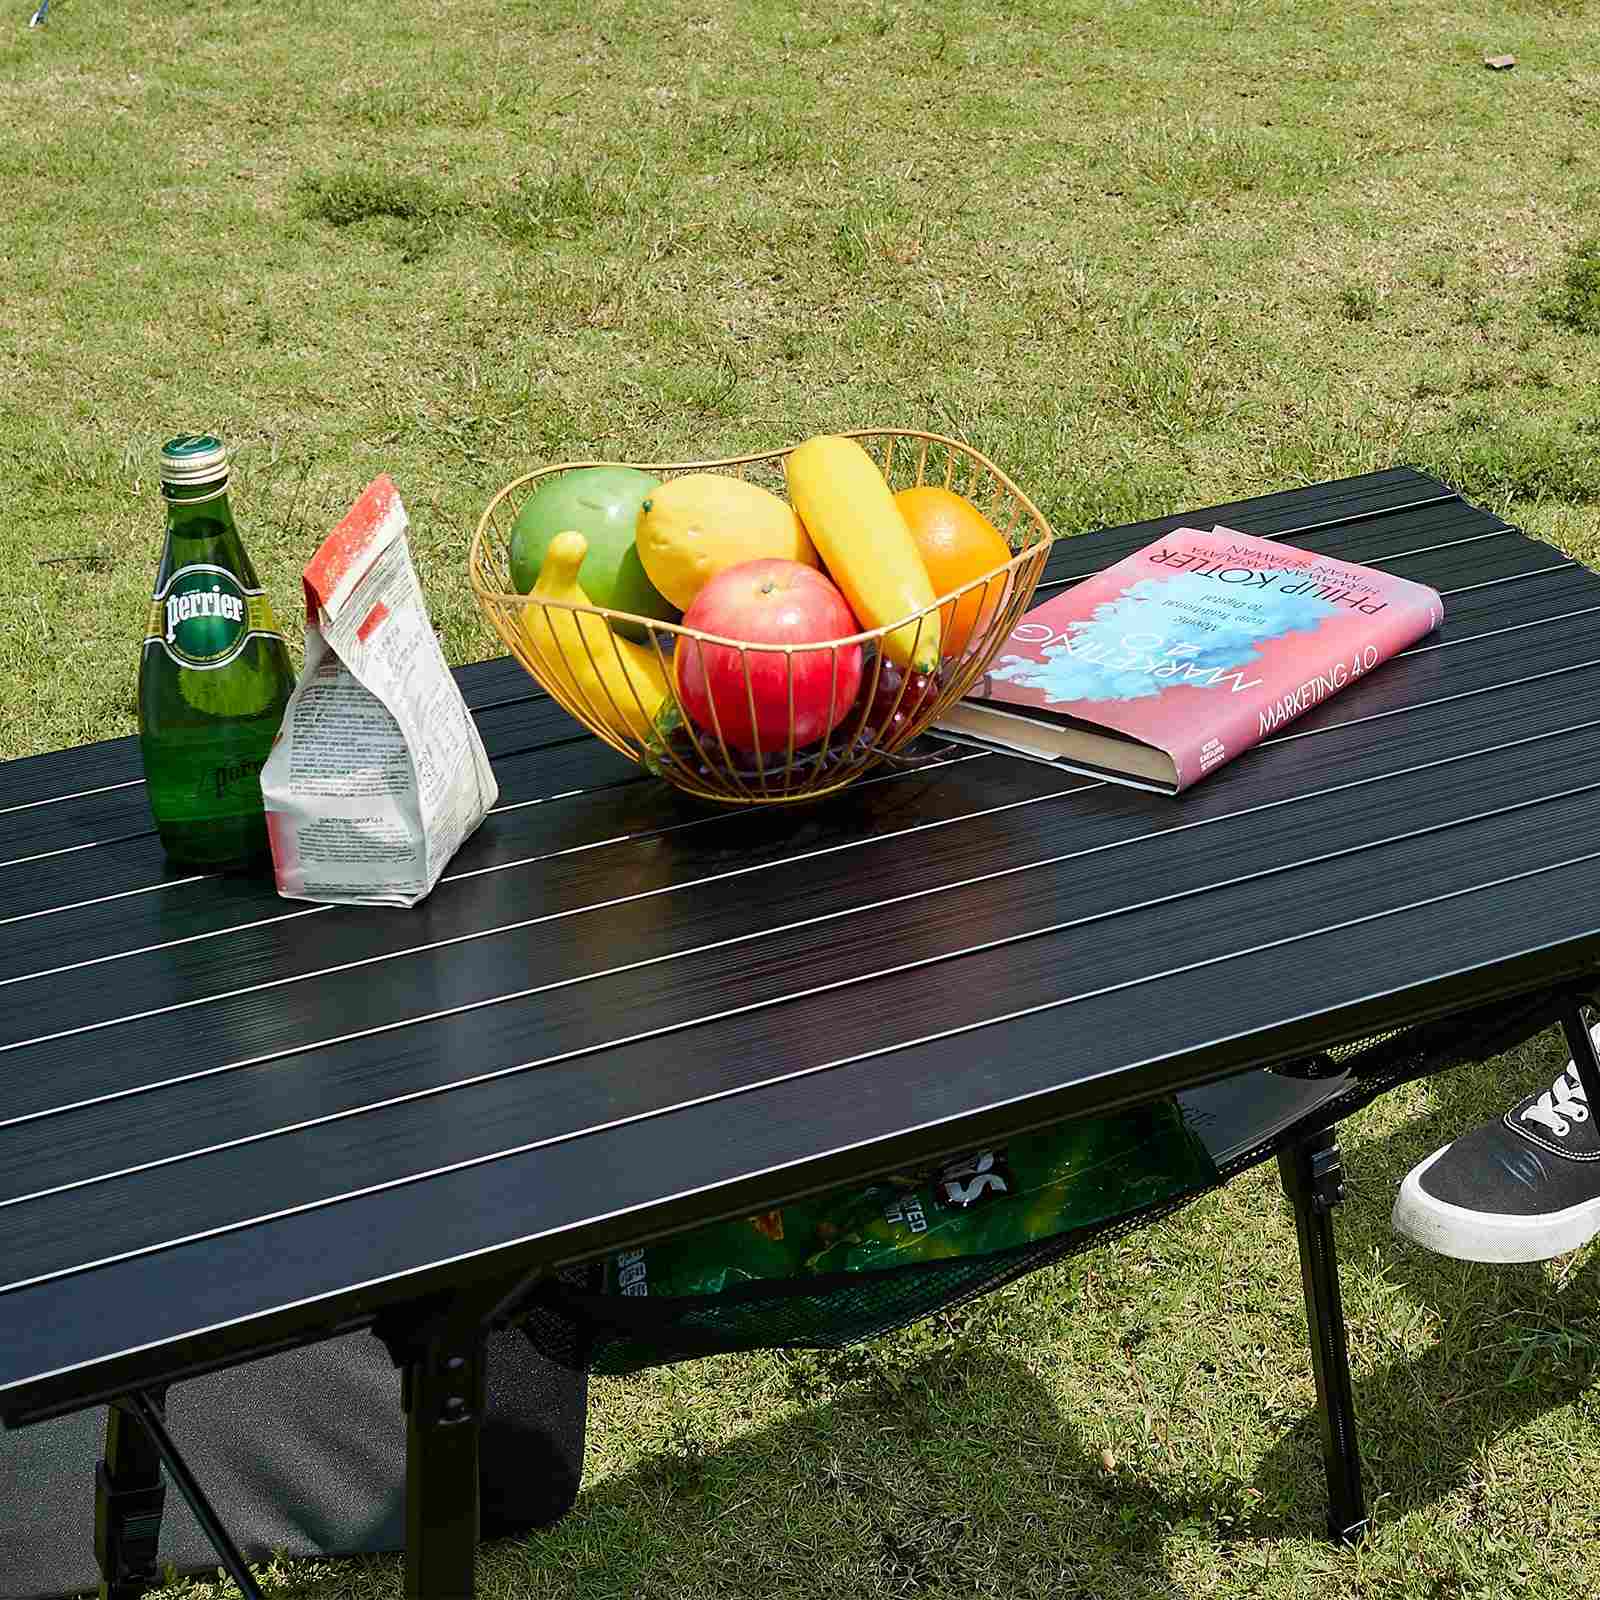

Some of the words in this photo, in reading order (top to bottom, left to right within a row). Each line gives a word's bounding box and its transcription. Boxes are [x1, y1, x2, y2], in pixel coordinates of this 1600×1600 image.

[1149, 548, 1279, 589] KOTLER
[1279, 581, 1388, 615] PHILIP
[166, 584, 243, 644] perrier
[1010, 623, 1263, 693] MARKETING
[1259, 663, 1348, 736] MARKETING
[1351, 645, 1378, 677] 4.0
